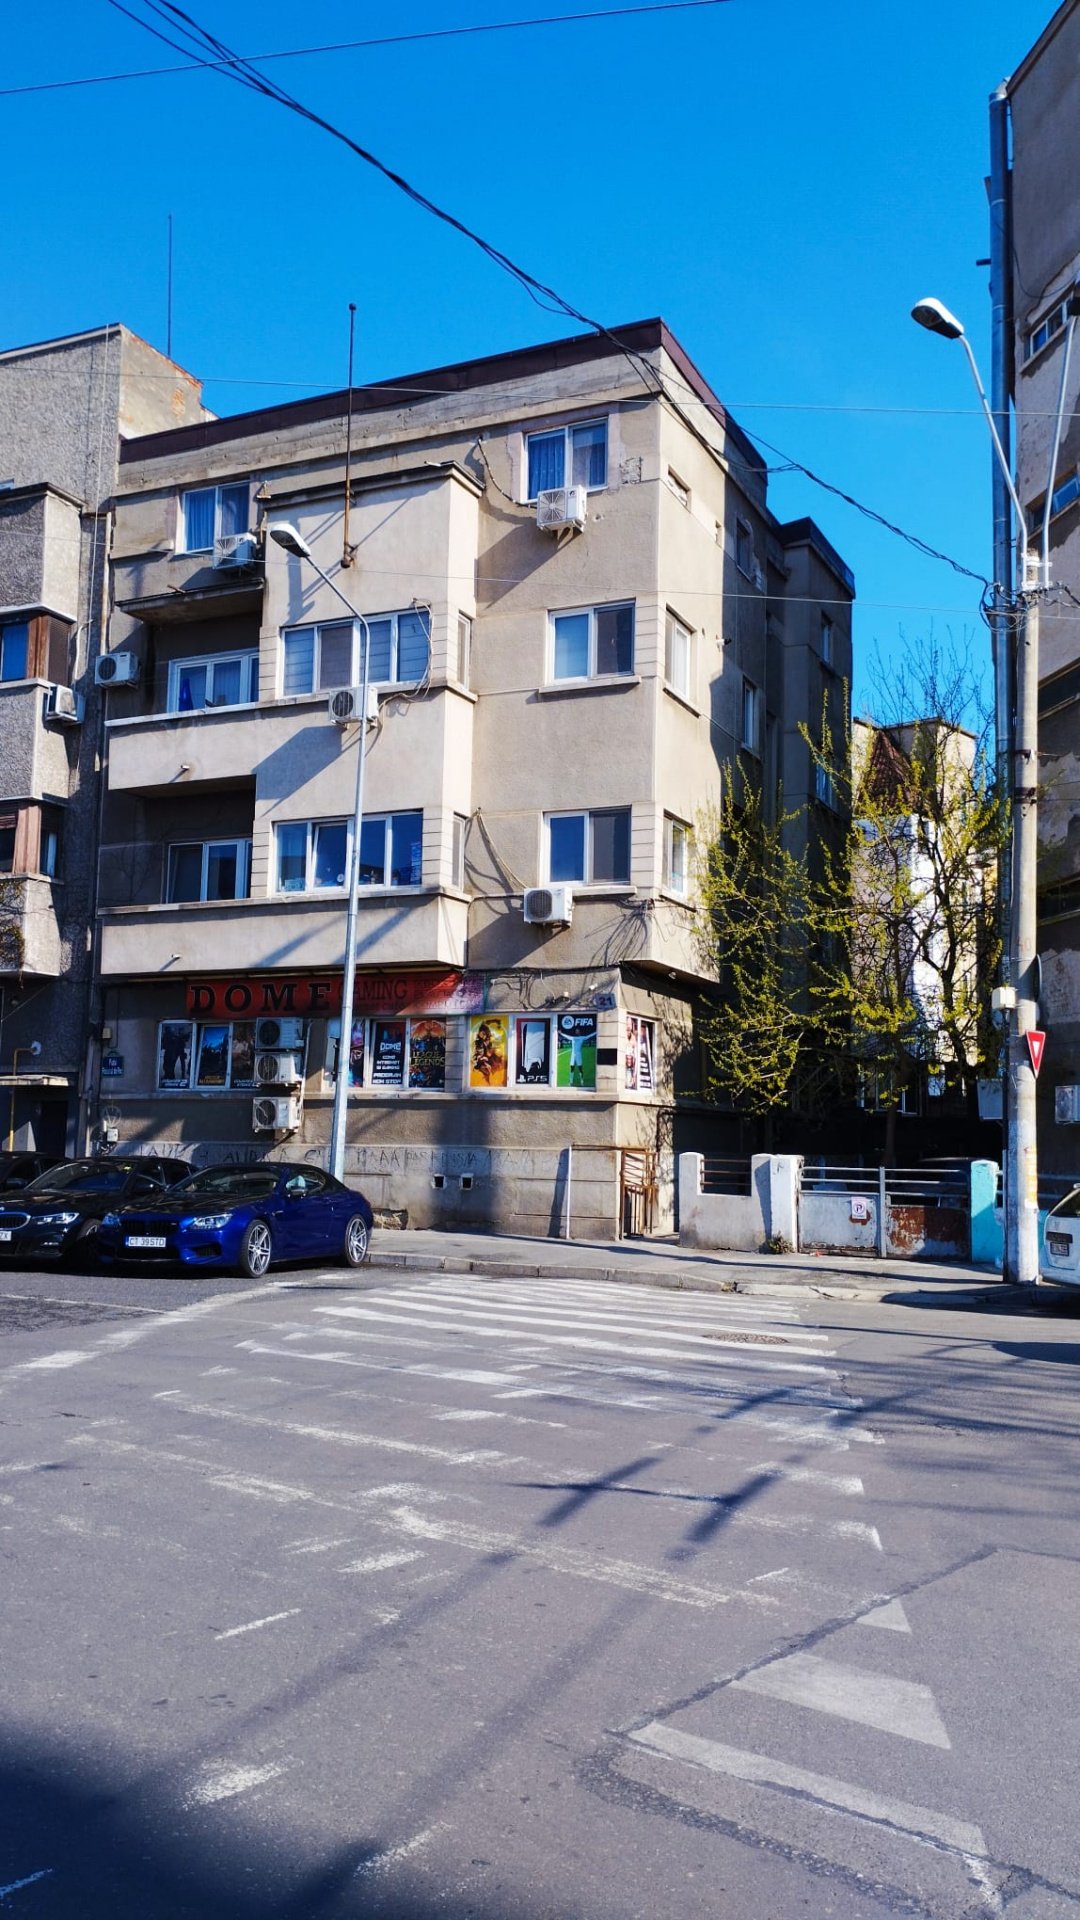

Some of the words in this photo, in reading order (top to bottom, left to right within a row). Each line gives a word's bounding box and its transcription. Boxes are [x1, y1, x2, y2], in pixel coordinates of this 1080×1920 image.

[189, 983, 332, 1012] DOME
[599, 996, 614, 1006] 21
[575, 1018, 594, 1026] FIFA
[412, 1051, 441, 1059] LEAGUE
